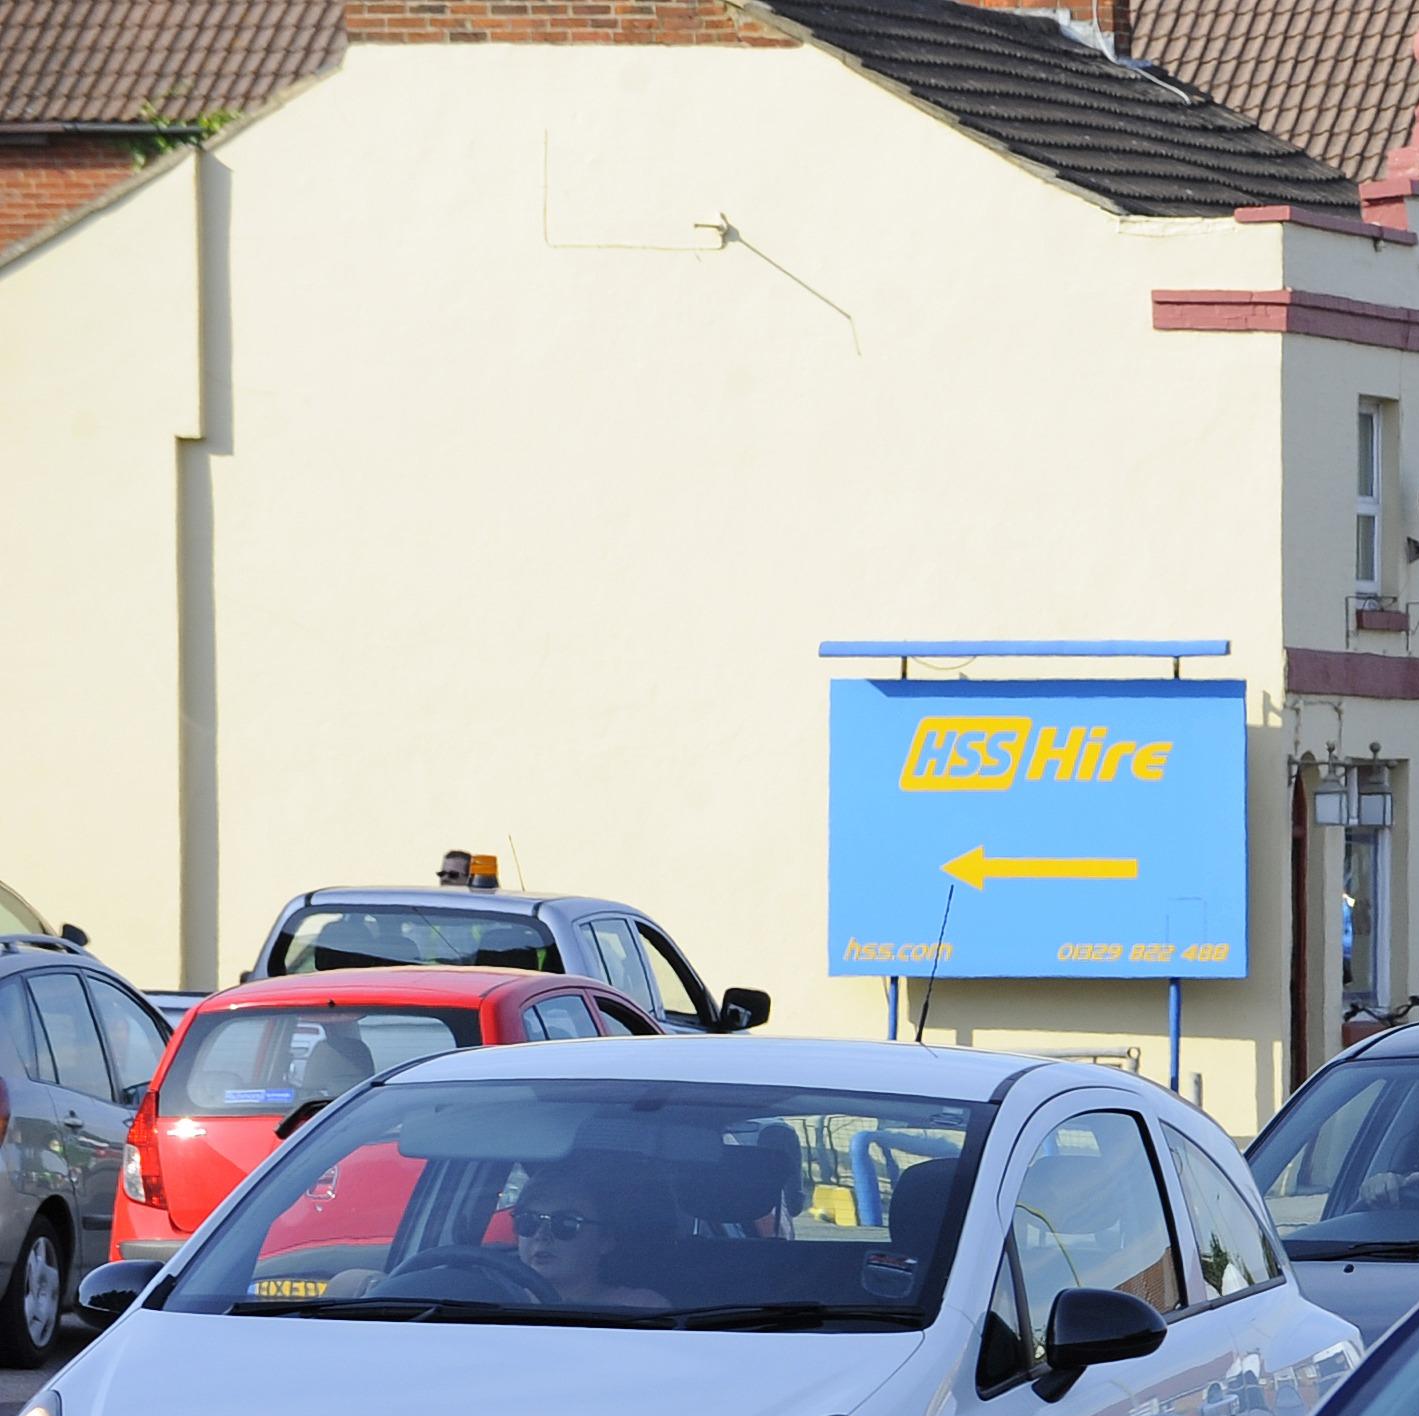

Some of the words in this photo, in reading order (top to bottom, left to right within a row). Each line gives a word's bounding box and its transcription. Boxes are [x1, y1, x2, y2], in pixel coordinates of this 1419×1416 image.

[910, 727, 1019, 778] HSS
[1025, 726, 1173, 782] Hire
[843, 936, 953, 962] hss.com
[1057, 942, 1123, 961] 01329
